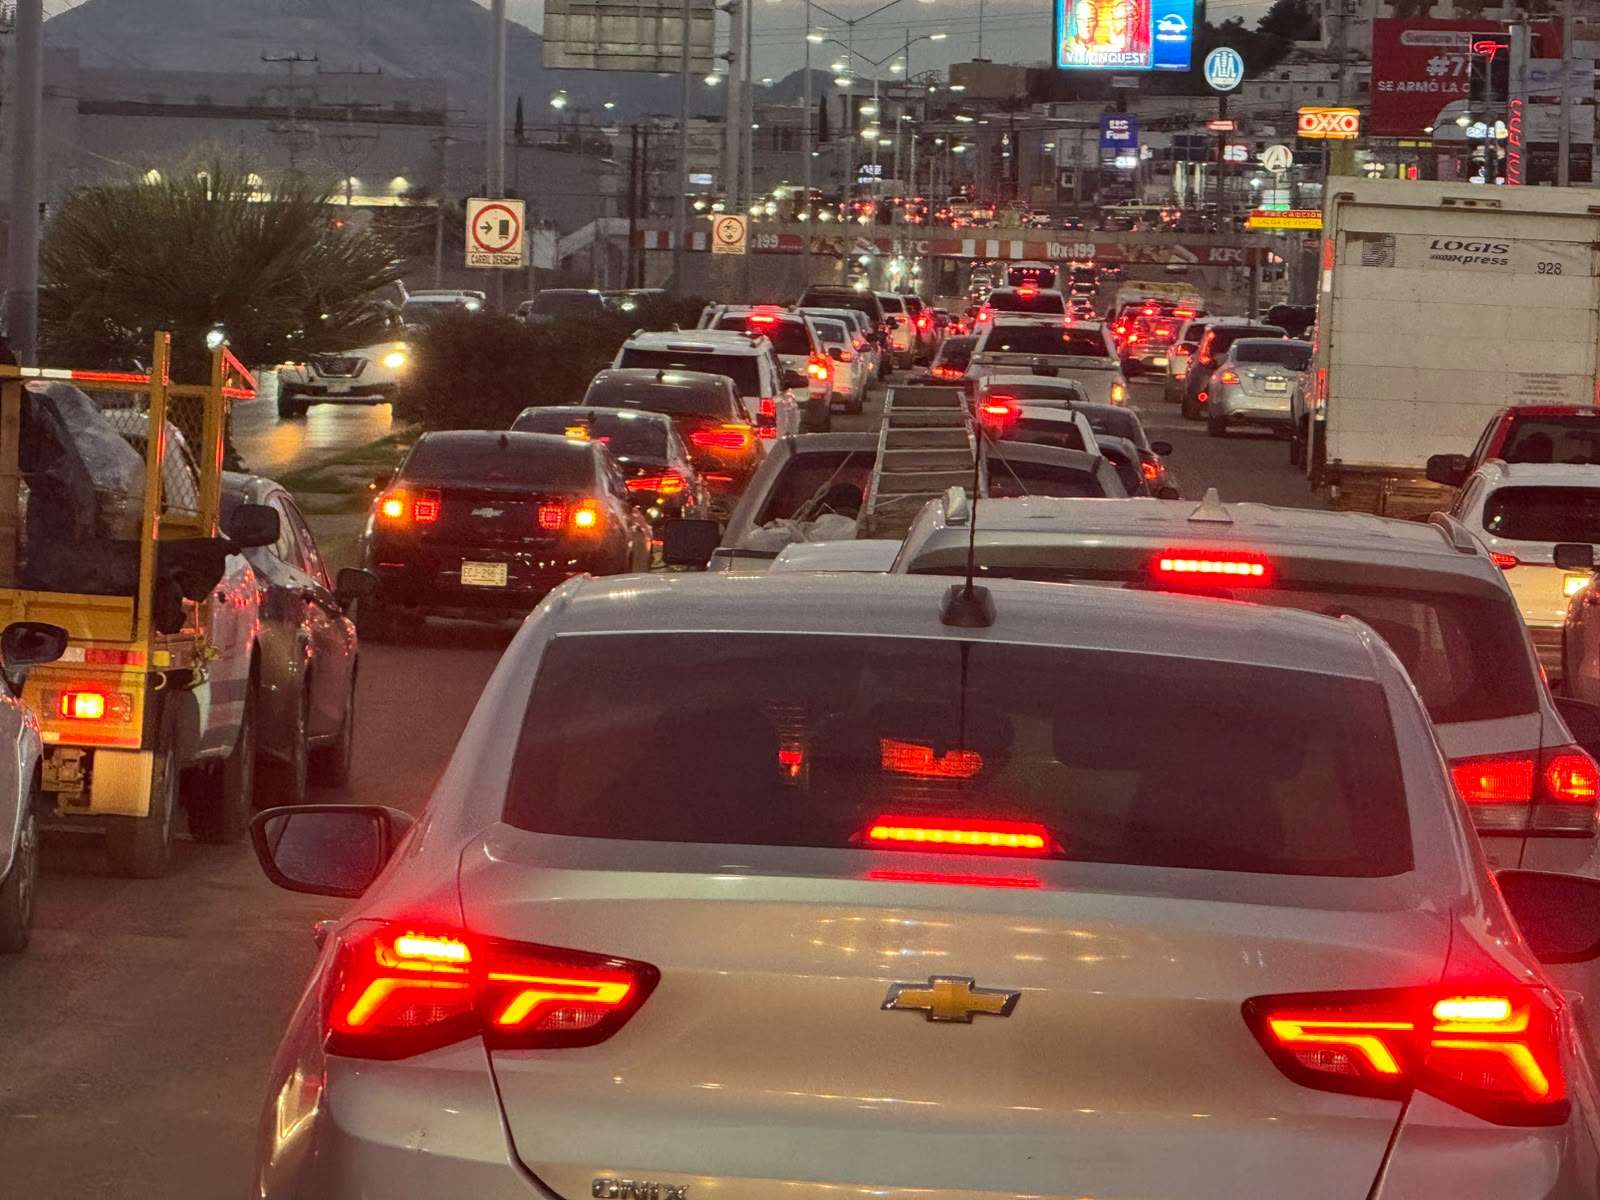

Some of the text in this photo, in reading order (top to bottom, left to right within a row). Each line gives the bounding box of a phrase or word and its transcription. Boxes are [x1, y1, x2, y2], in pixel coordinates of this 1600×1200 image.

[1377, 80, 1394, 92] SE
[1441, 82, 1459, 93] LA
[1299, 113, 1359, 132] OXXO
[1430, 239, 1510, 255] LOGIS
[1536, 261, 1562, 276] 928
